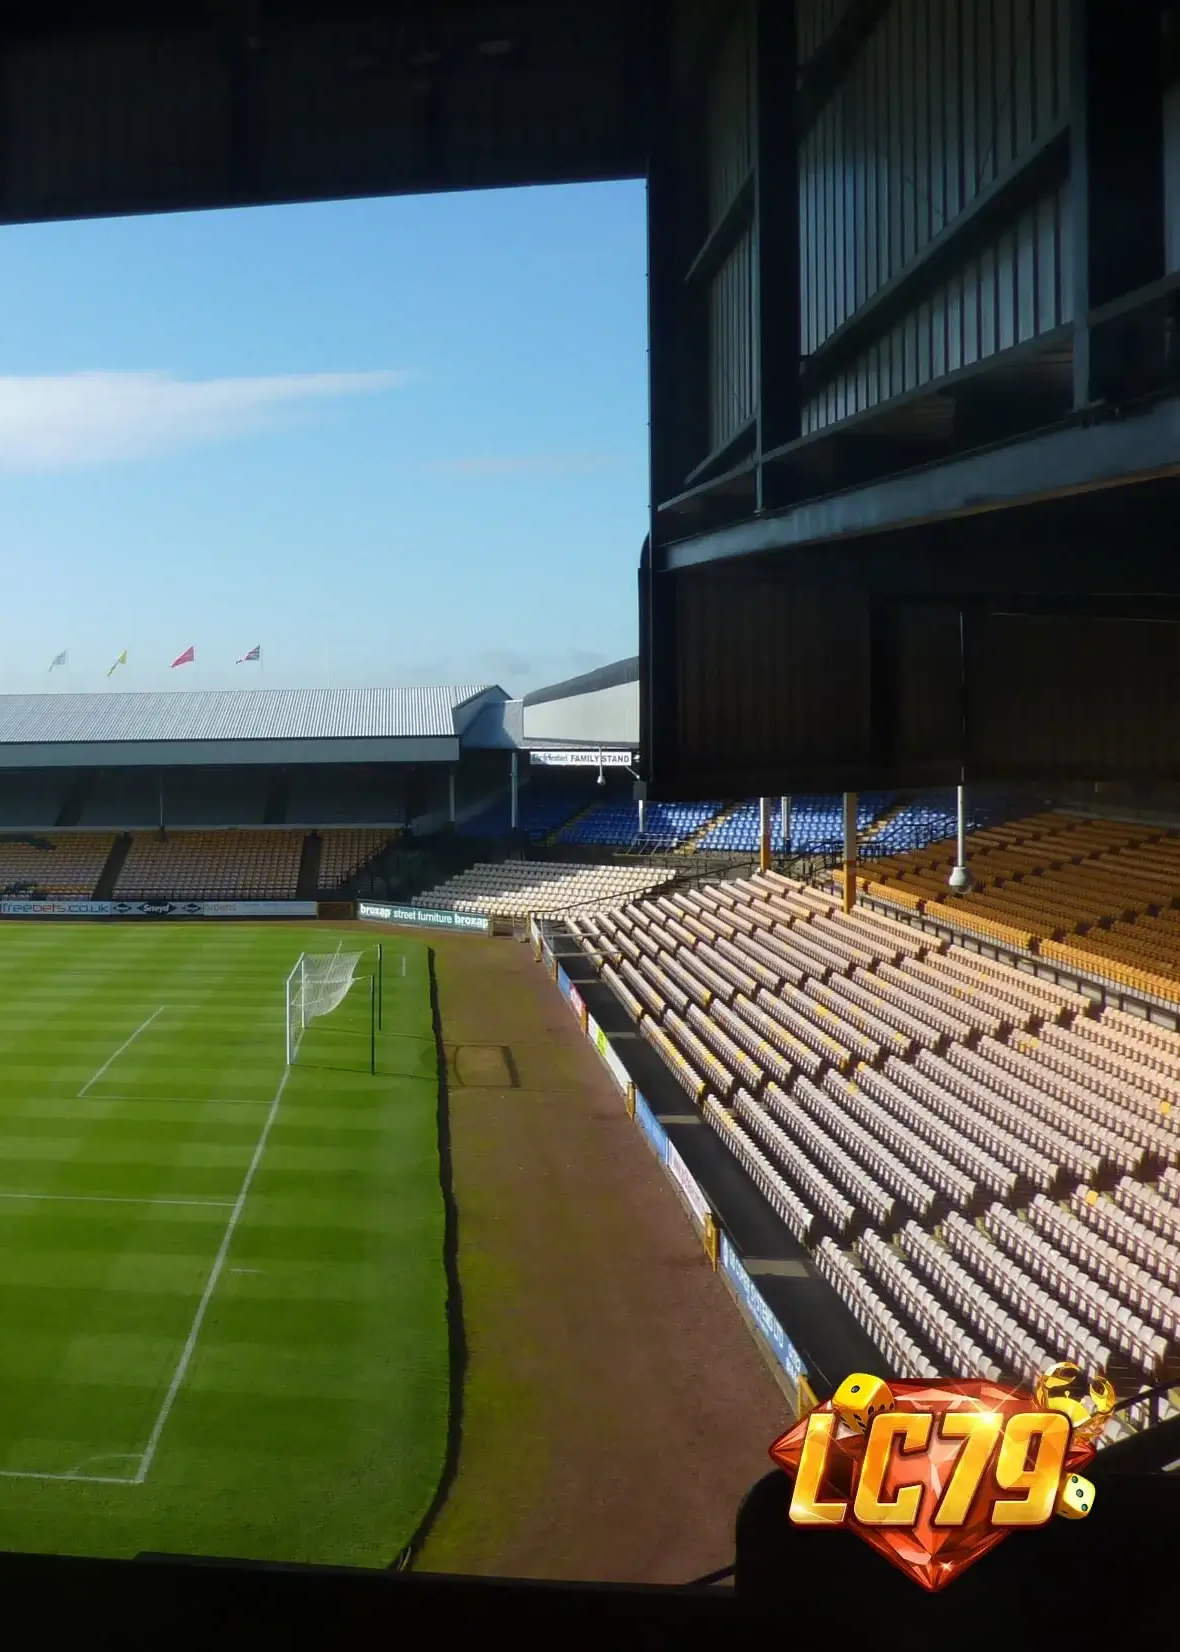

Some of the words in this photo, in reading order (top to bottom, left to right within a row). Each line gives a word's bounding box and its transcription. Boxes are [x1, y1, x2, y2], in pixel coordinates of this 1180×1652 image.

[571, 754, 600, 763] FAMILY
[601, 754, 630, 763] STAND
[0, 902, 109, 914] freebets.co.uk
[142, 903, 170, 915] Sneyd
[360, 903, 391, 918] broxap
[393, 910, 417, 921] street
[418, 911, 453, 924] furniture
[454, 914, 489, 929] broxap
